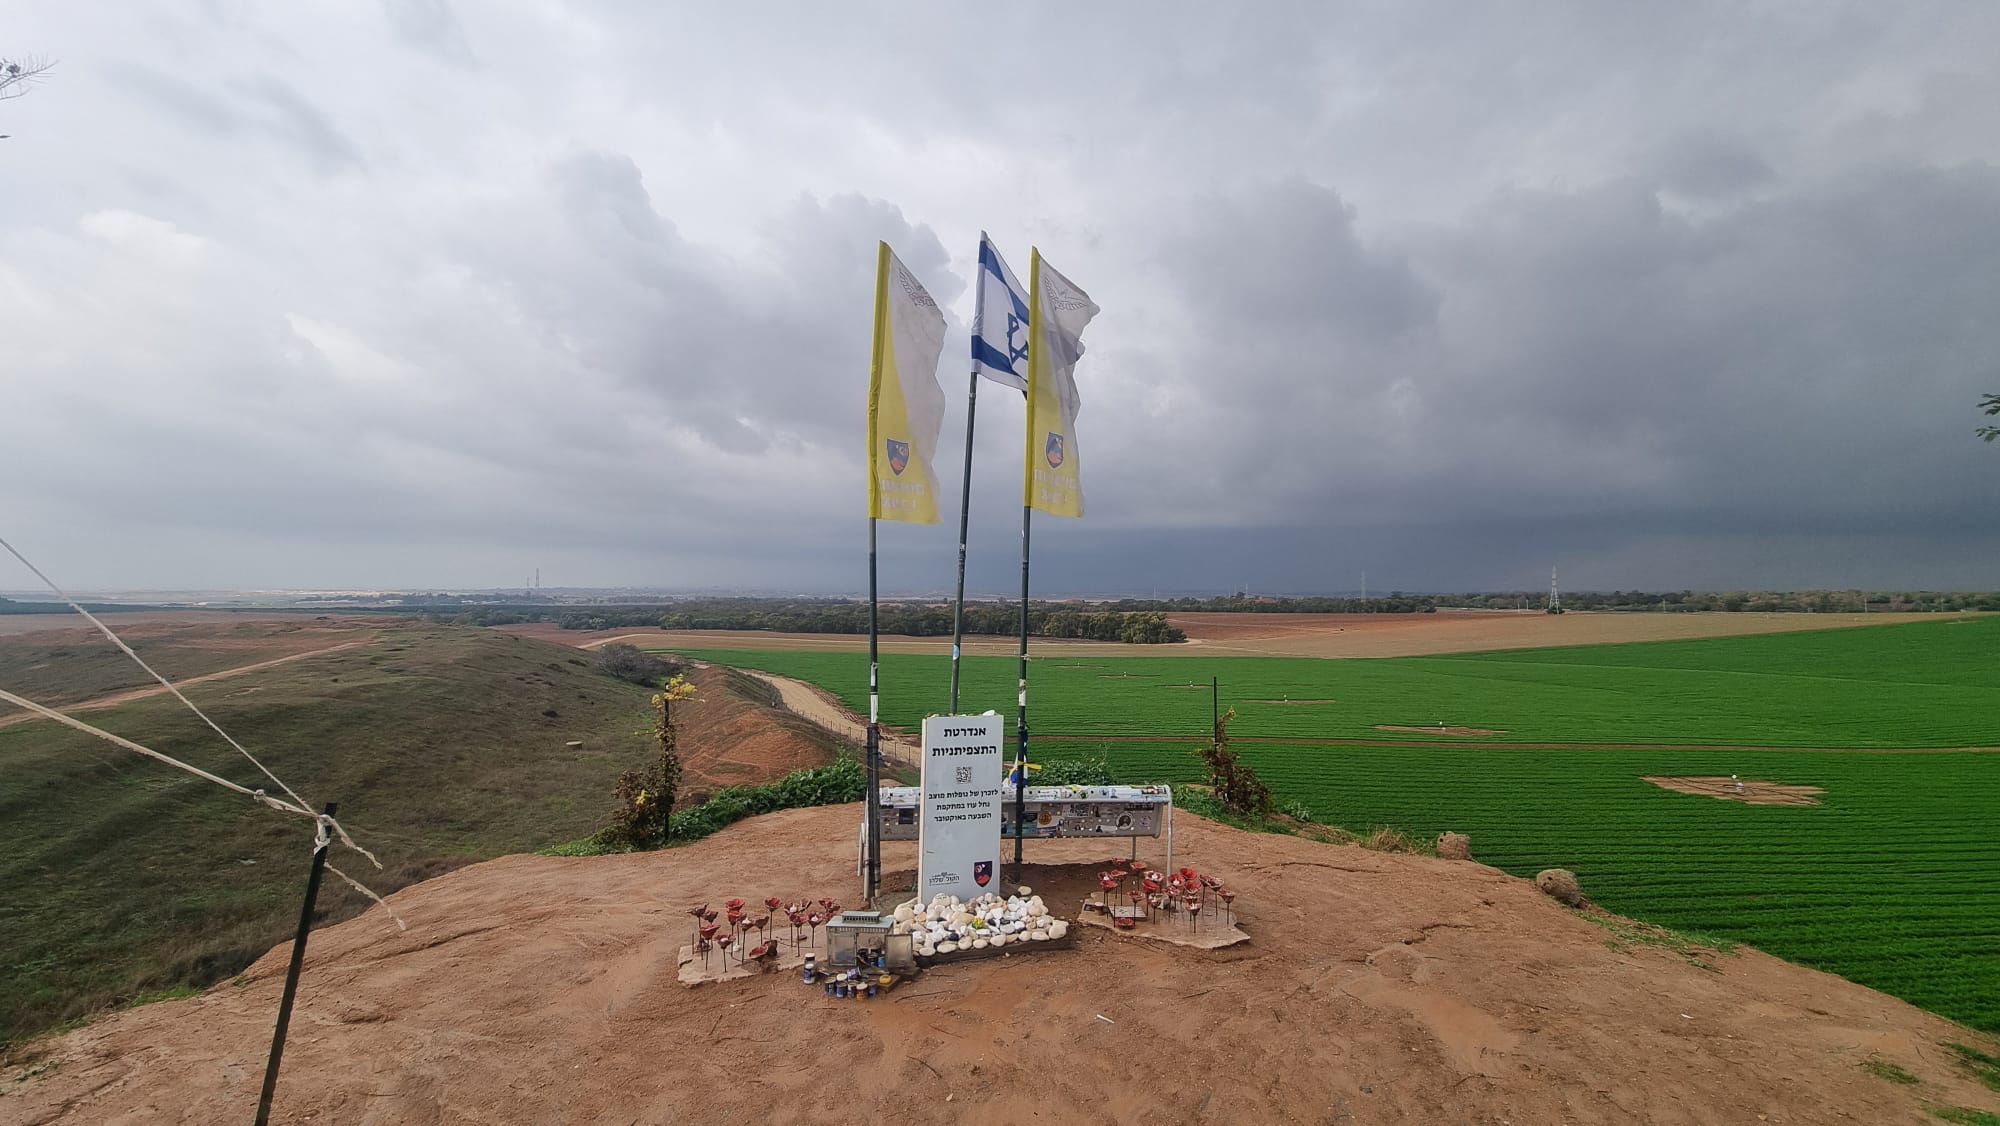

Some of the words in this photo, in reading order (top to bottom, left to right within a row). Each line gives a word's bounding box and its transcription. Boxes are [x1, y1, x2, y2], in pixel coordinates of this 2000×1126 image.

[944, 727, 986, 738] אנדרטת
[932, 745, 997, 757] התצפיתניות
[946, 791, 968, 799] נופלות
[969, 789, 979, 797] של
[981, 788, 998, 797] לזכרן
[936, 803, 965, 811] במתקפת
[934, 814, 966, 822] באוקטובר
[968, 812, 992, 820] השבעה
